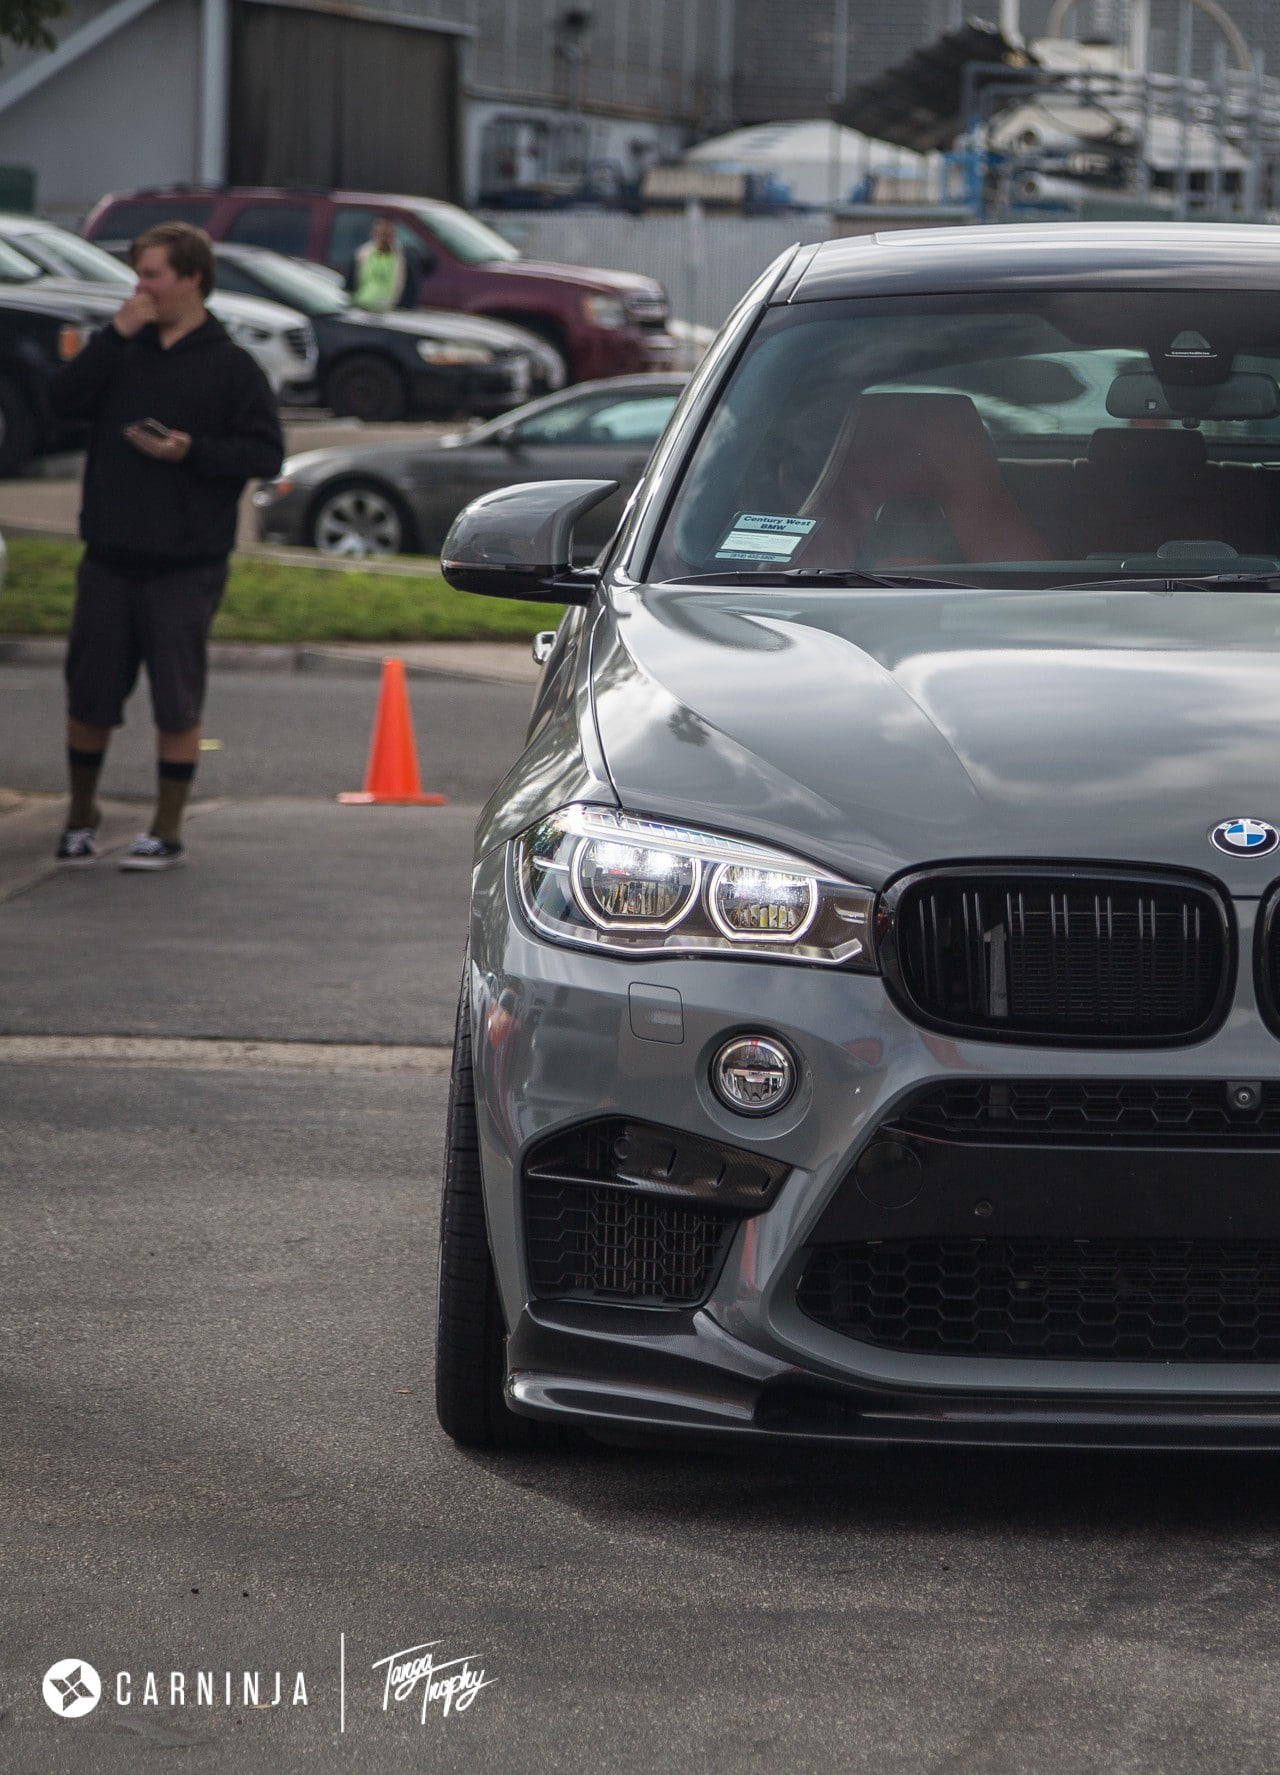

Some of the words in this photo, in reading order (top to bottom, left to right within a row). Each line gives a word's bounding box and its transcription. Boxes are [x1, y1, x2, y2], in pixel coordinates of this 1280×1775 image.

[744, 515, 783, 525] Century
[786, 519, 811, 527] West
[760, 523, 787, 531] BMW
[1218, 818, 1275, 831] BMW
